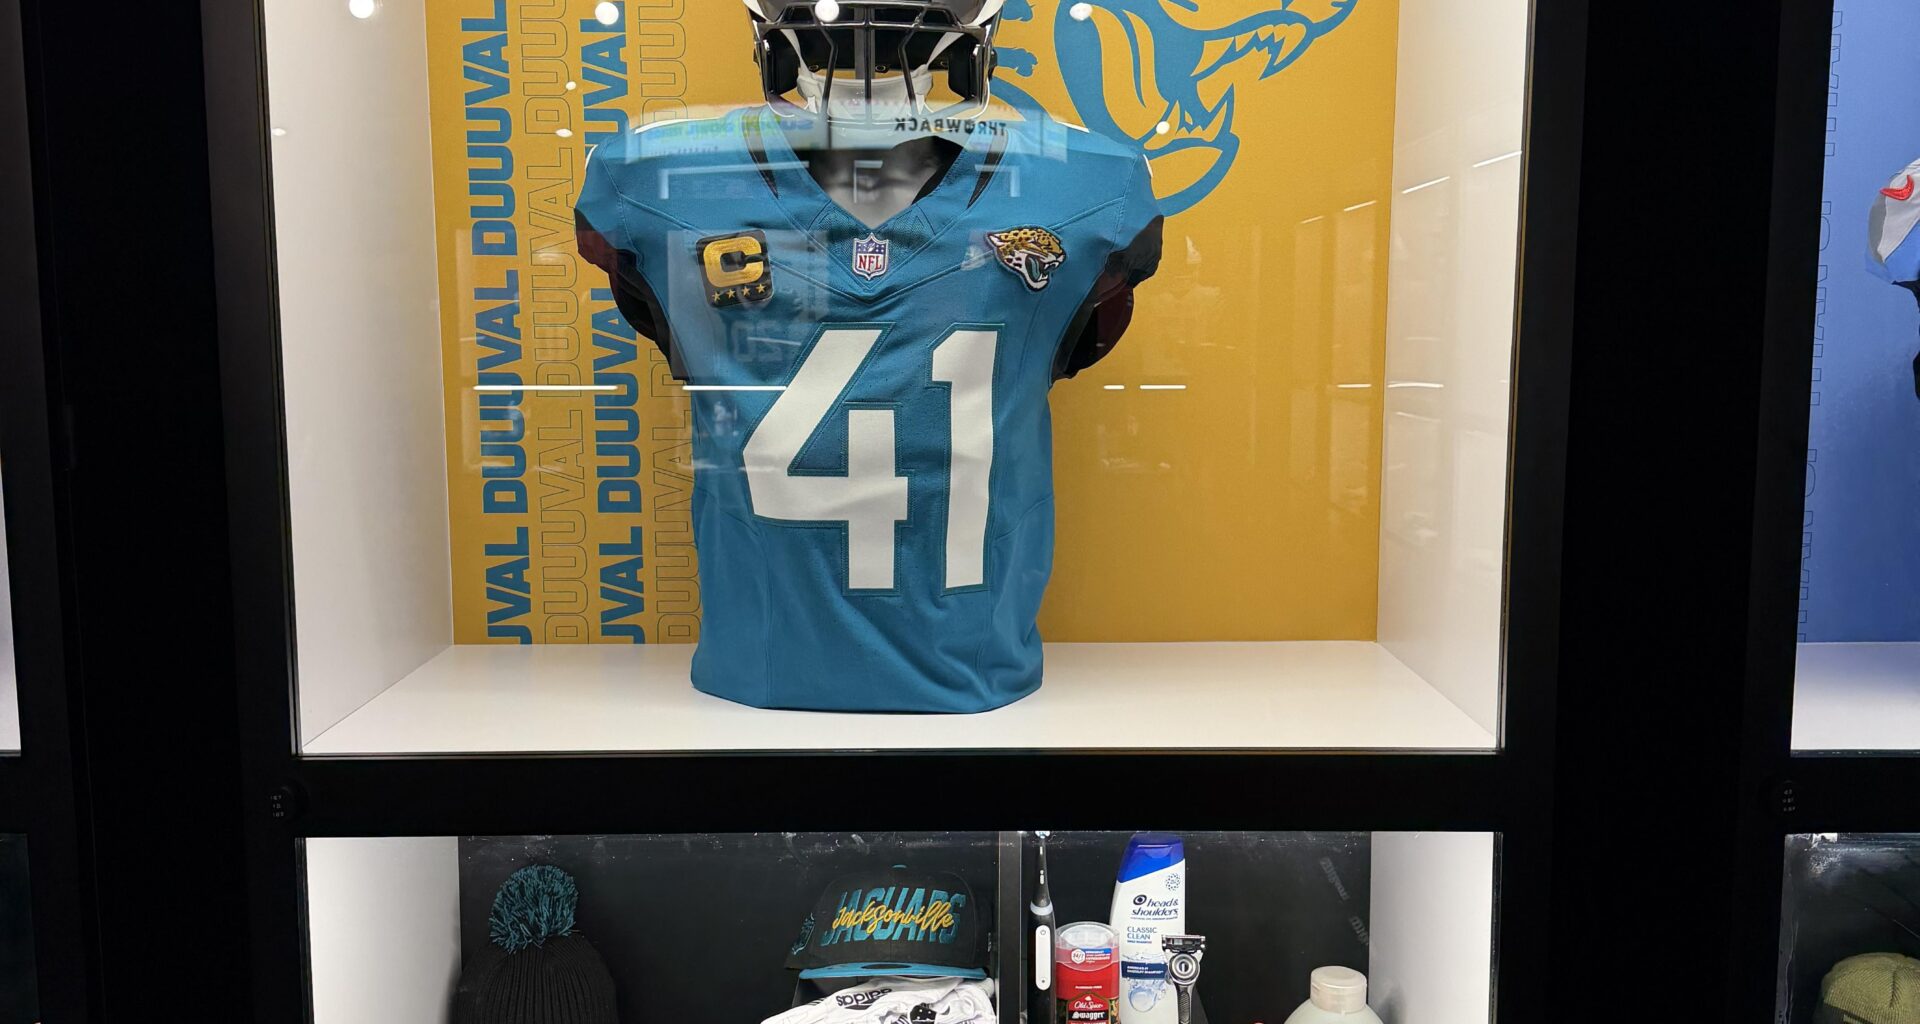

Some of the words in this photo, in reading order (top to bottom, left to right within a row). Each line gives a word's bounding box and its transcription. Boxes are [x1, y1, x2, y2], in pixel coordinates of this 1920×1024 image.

[461, 0, 517, 255] DUUUVAL
[527, 147, 582, 397] DUUUVAL
[703, 236, 764, 288] C
[858, 254, 883, 271] NFL
[474, 270, 528, 513] DUUUVAL
[742, 325, 1002, 594] 41
[538, 409, 590, 644] DUUUVAL
[821, 886, 966, 947] JAGUARS
[832, 900, 955, 934] Jacksonville
[1132, 907, 1178, 916] shoulders
